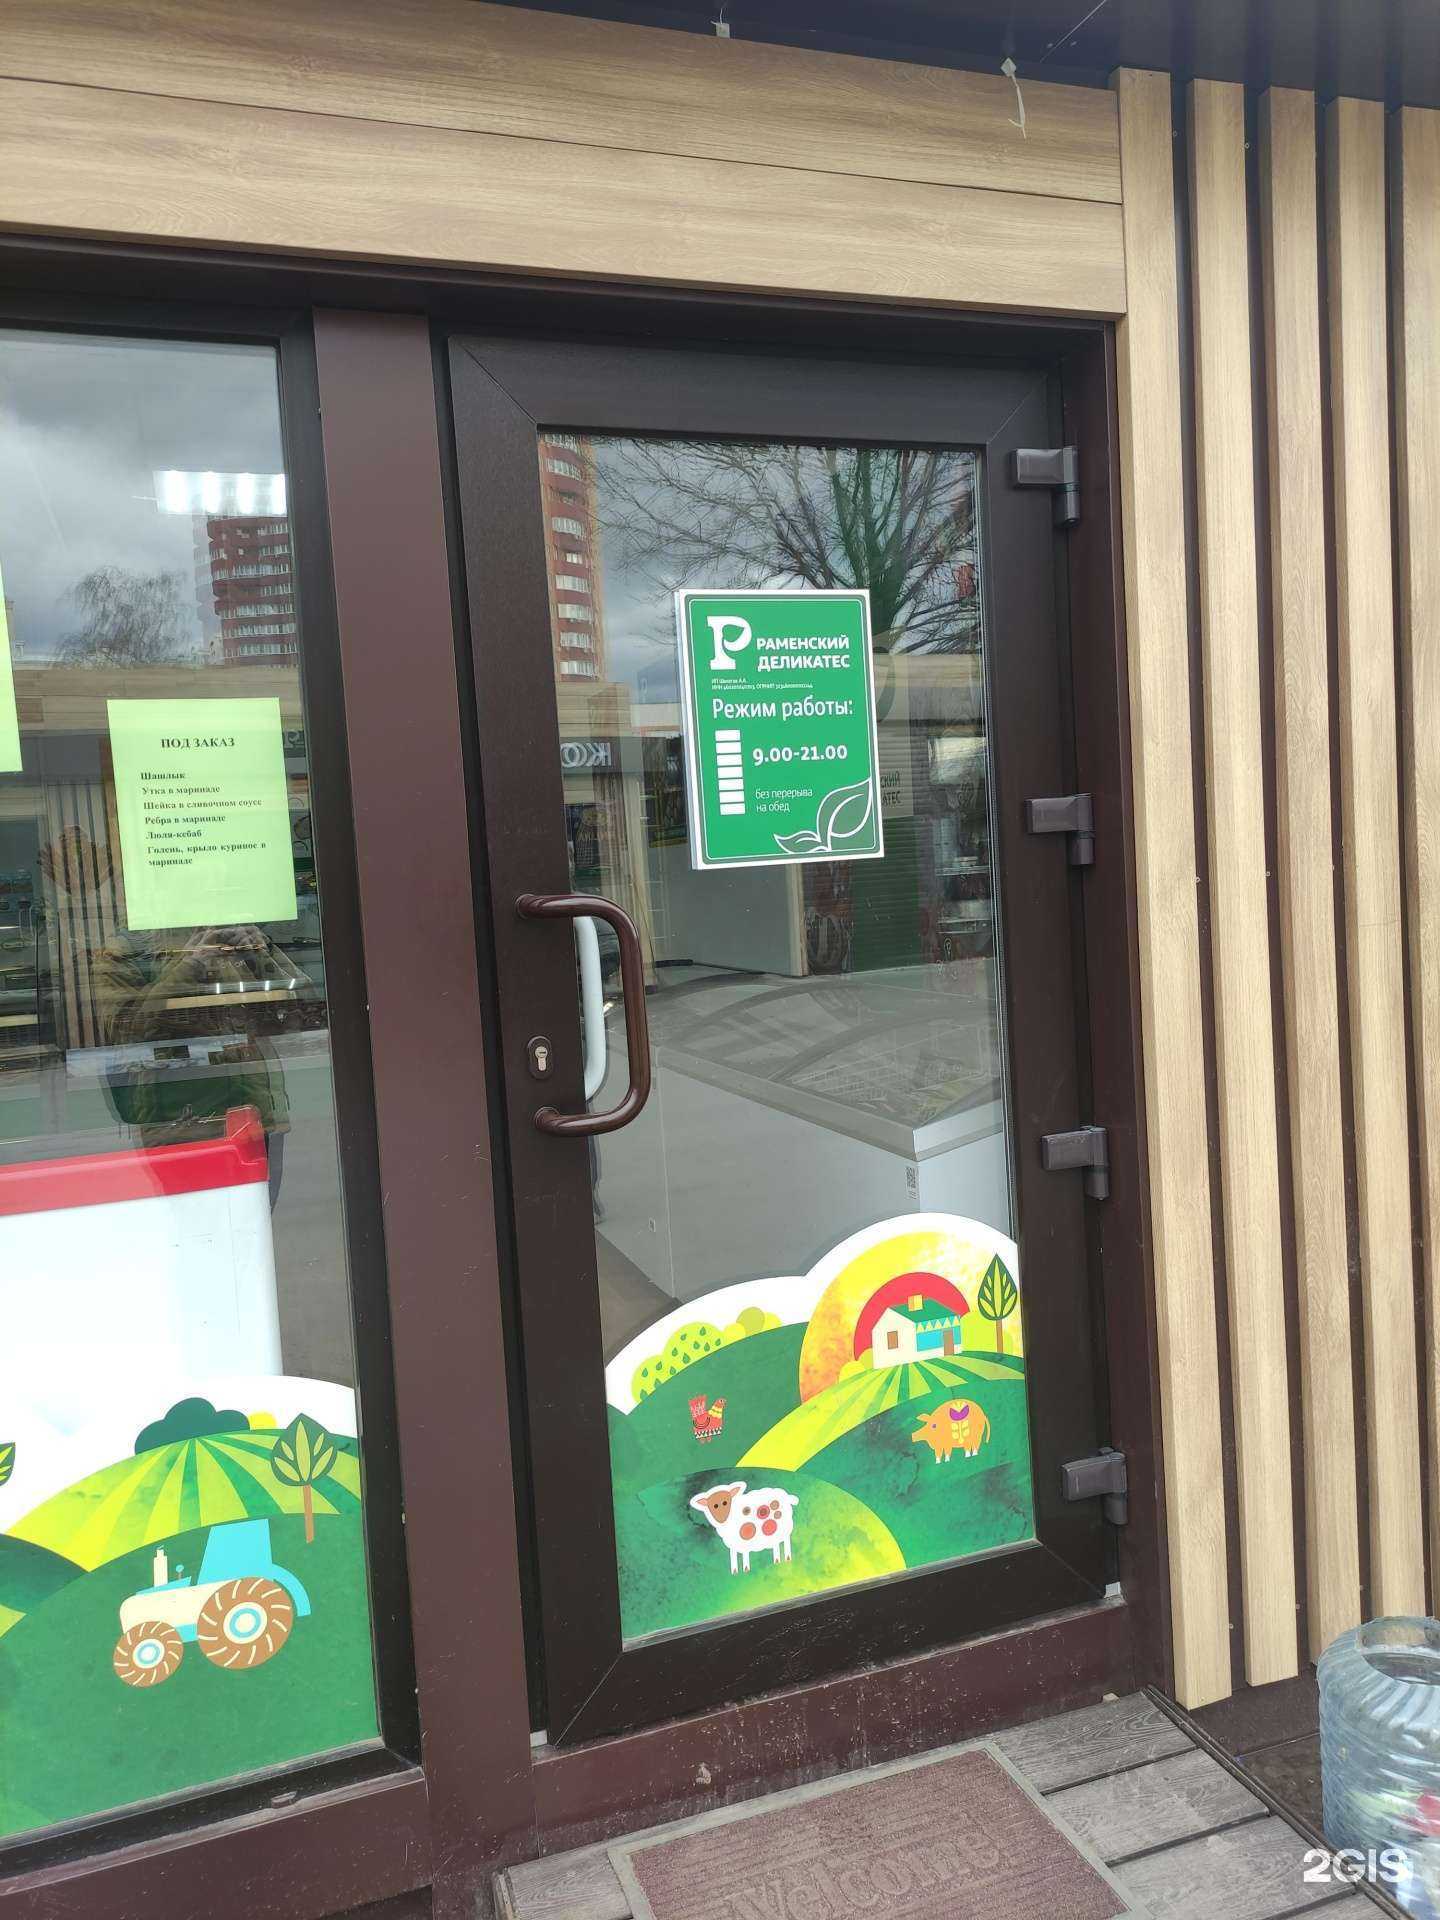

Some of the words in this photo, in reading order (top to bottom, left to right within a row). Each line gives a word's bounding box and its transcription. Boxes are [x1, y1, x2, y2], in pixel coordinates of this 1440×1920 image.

[756, 634, 850, 650] РАМЕНСКИЙ
[757, 654, 850, 672] ДЕЛИКАТЕС
[712, 698, 776, 719] Режим
[782, 695, 853, 721] работы:
[161, 738, 191, 749] ПОД
[193, 737, 235, 748] ЗАКАЗ
[752, 745, 848, 767] 9.00-21.00
[140, 772, 186, 780] Шашлык
[142, 787, 166, 795] Утка
[176, 786, 221, 795] маринаде
[755, 788, 769, 799] без
[771, 788, 813, 801] перерыва
[143, 801, 176, 809] Шейка
[238, 799, 262, 807] соусе
[756, 804, 767, 812] на
[769, 802, 790, 813] обед
[145, 817, 172, 826] Ребра
[182, 815, 226, 824] маринаде
[146, 830, 202, 839] Люля-кебаб
[147, 846, 184, 854] Голень,
[187, 845, 217, 853] крыло
[220, 843, 258, 852] куриное
[148, 858, 193, 867] маринаде
